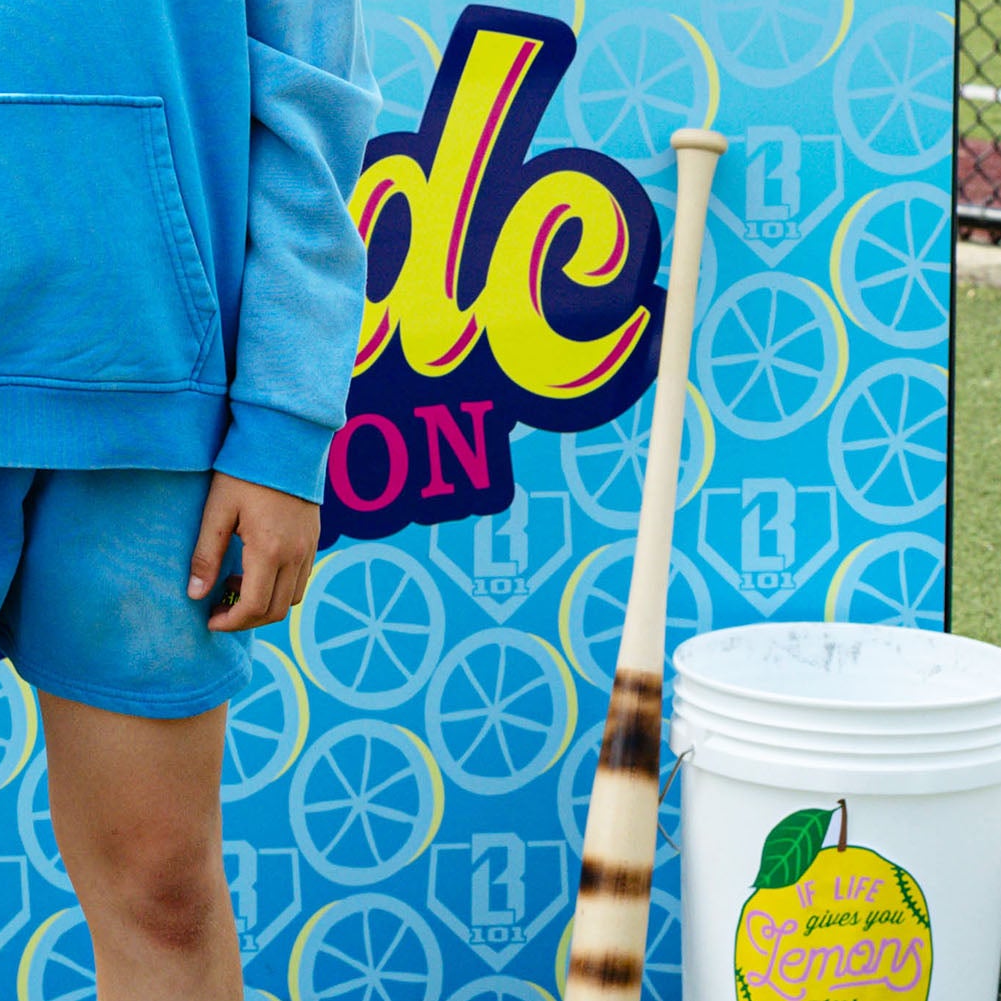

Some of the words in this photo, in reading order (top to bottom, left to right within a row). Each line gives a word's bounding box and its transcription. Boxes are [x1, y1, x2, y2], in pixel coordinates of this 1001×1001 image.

[744, 222, 802, 239] 101
[473, 578, 530, 596] 101
[740, 572, 797, 590] 101
[796, 880, 816, 909] IF
[833, 875, 885, 903] LIFE
[803, 909, 860, 937] gives
[862, 909, 905, 932] you
[470, 927, 527, 944] 101
[746, 910, 925, 1001] Lemons
